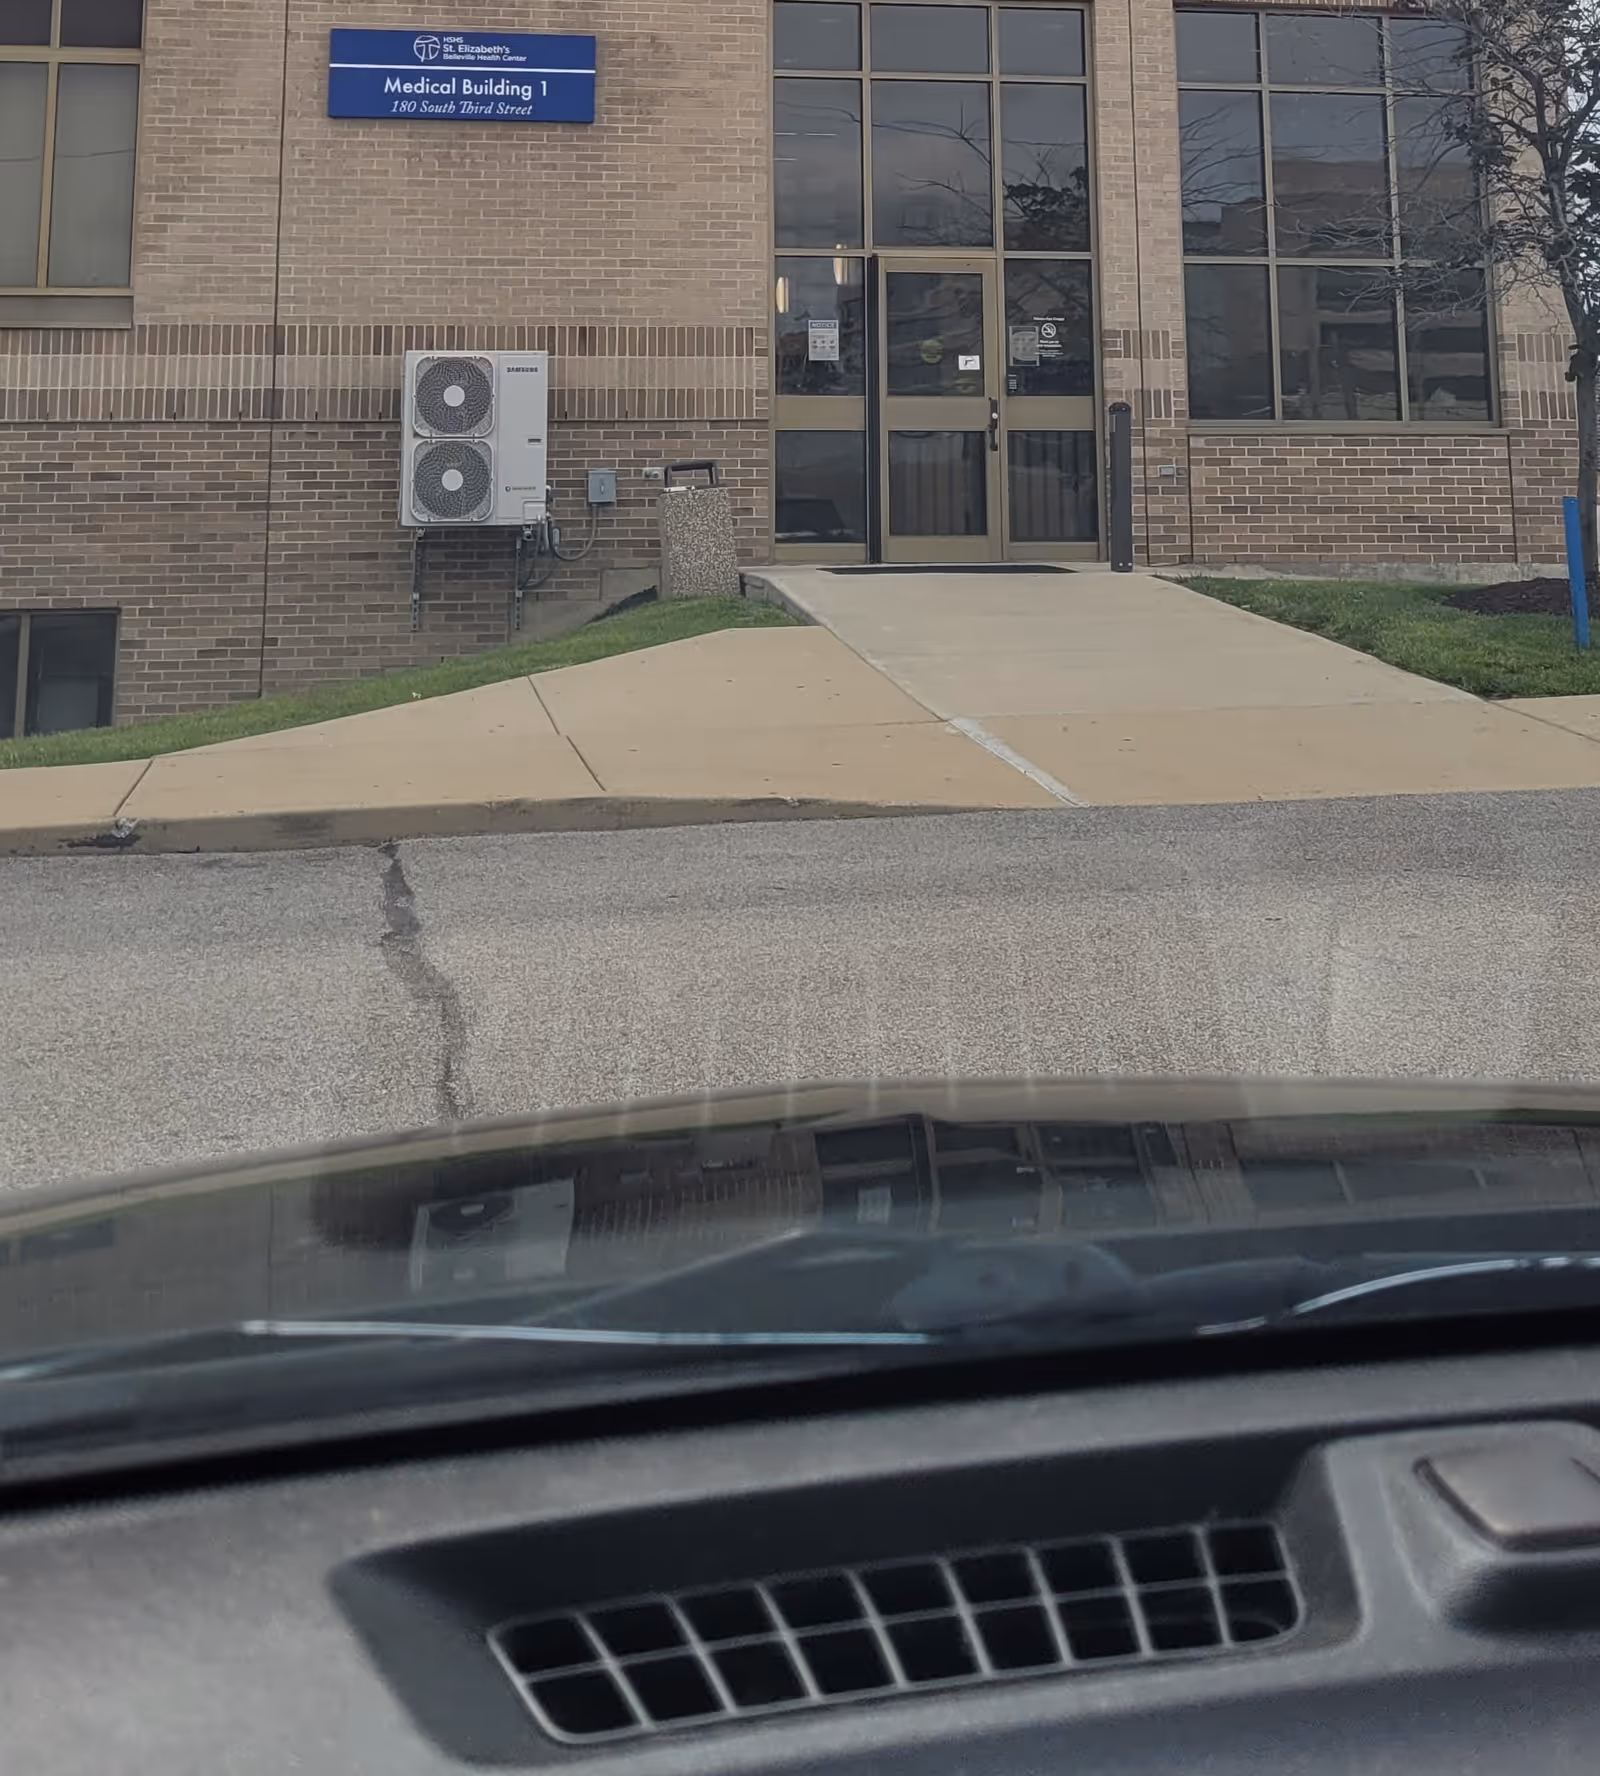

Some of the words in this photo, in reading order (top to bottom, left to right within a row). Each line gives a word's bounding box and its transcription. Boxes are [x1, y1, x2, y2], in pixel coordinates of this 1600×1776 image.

[443, 44, 455, 53] St.
[458, 44, 510, 54] Elizabeth's
[443, 53, 476, 61] Belleville
[384, 76, 456, 94] Medical
[462, 78, 532, 100] Building
[540, 81, 547, 96] 1
[390, 100, 417, 113] 180
[420, 100, 456, 114] South
[459, 101, 494, 115] Third
[496, 103, 533, 116] Street
